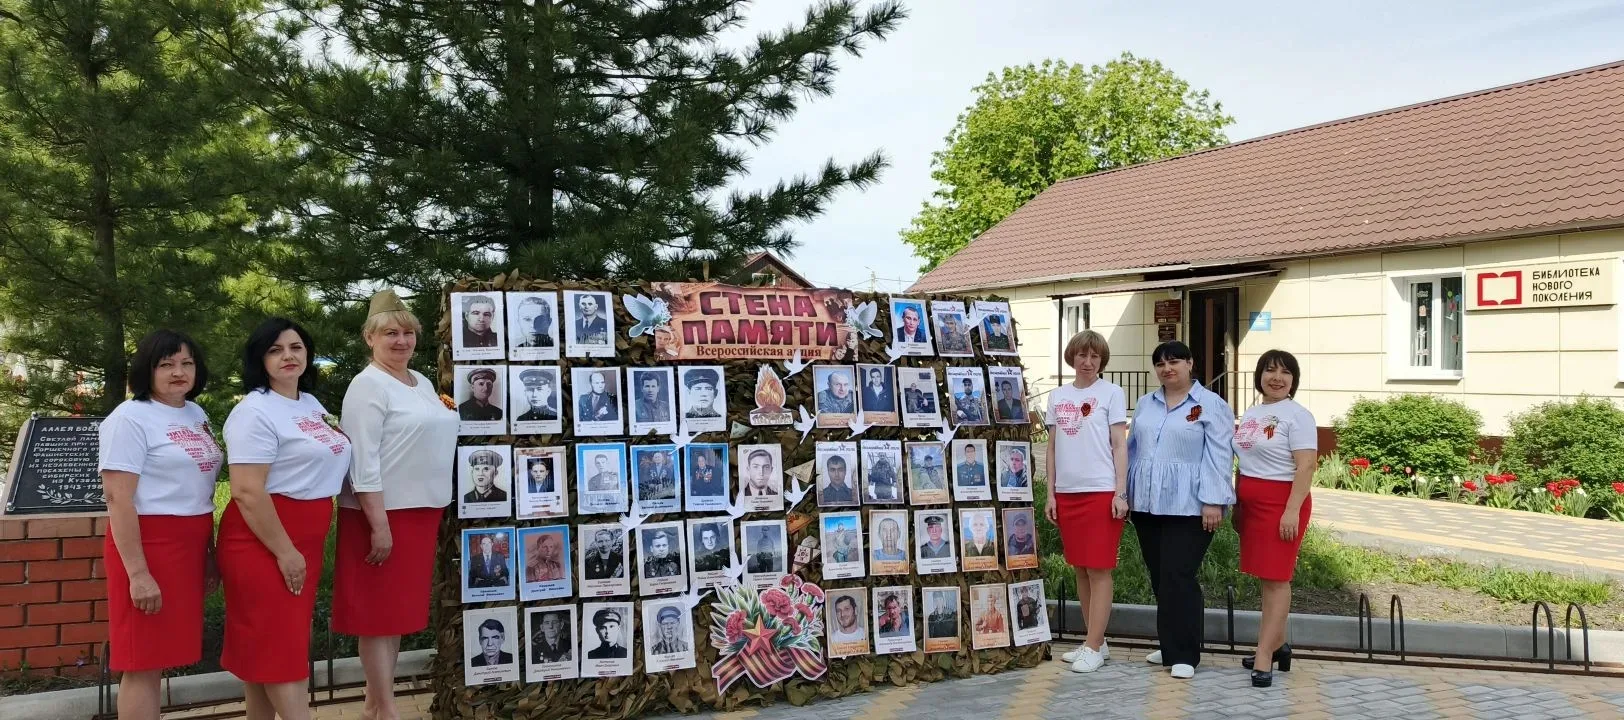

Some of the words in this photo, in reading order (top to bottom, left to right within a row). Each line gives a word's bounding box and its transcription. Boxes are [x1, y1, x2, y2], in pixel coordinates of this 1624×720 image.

[1532, 266, 1600, 280] БИБЛИОТЕКА
[1532, 280, 1573, 291] НОВОГО
[1532, 291, 1593, 303] ПОКОЛЕНИЯ
[700, 291, 817, 317] СТЕНА
[682, 319, 838, 346] ПАМЯТИ
[696, 345, 783, 358] Всероссийская
